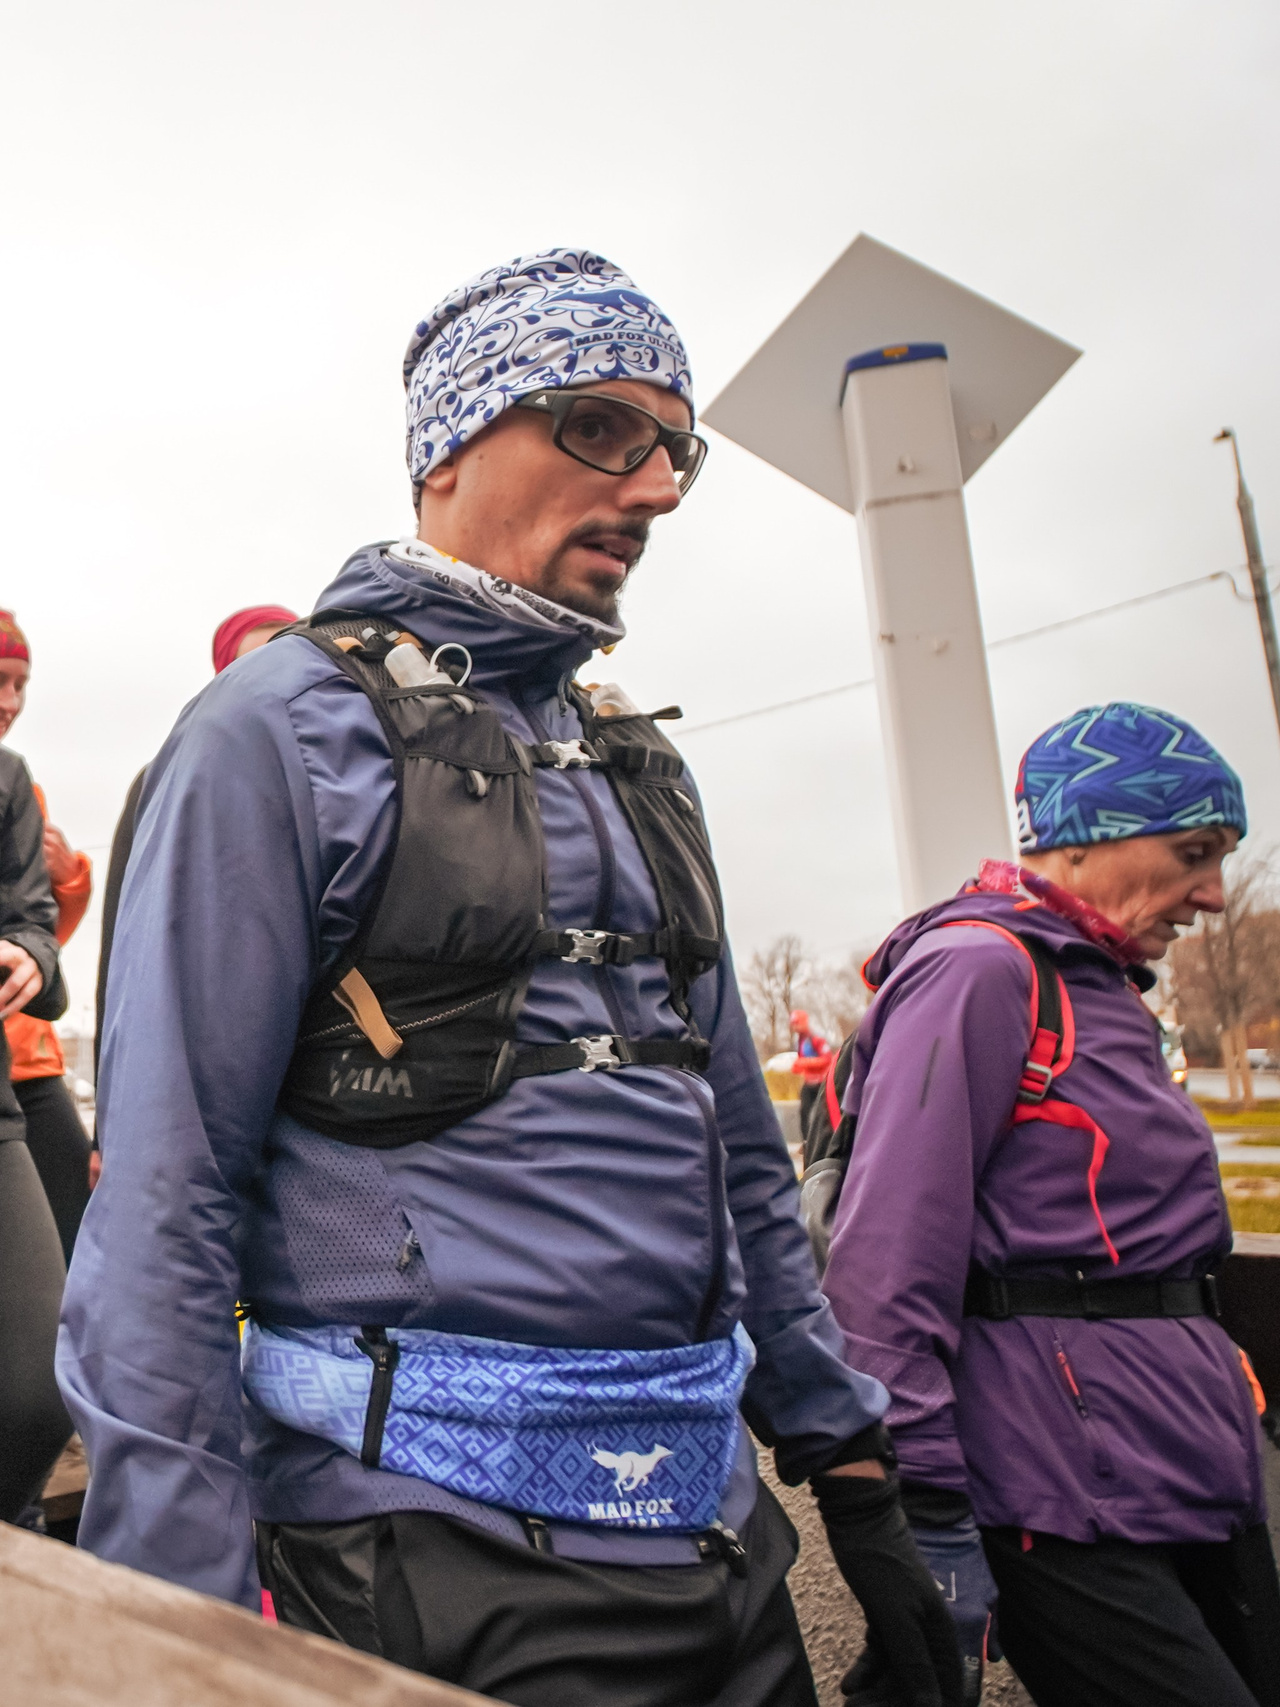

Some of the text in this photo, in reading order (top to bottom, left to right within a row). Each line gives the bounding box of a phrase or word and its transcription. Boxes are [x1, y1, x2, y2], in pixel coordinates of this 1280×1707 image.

[576, 331, 681, 357] MAD FOX ULTRA
[434, 571, 450, 585] 50
[588, 1498, 673, 1520] MAD FOX
